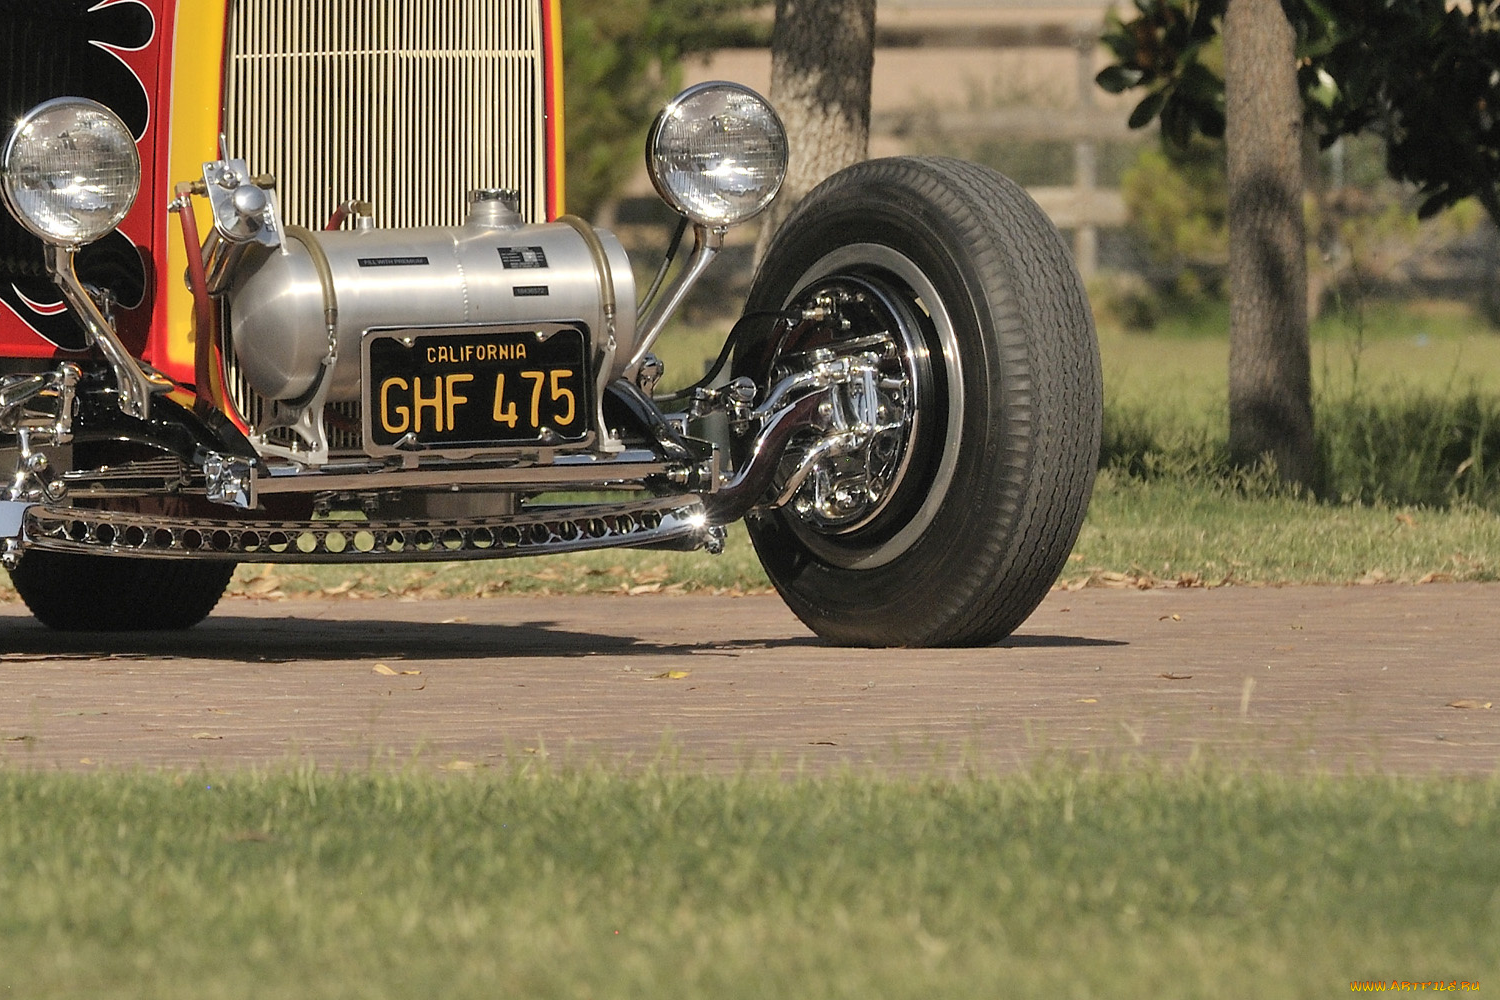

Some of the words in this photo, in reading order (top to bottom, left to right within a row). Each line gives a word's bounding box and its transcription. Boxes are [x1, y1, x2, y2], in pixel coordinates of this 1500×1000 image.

[427, 343, 527, 363] CALIFORNIA
[380, 374, 474, 434] GHF
[493, 369, 576, 428] 475
